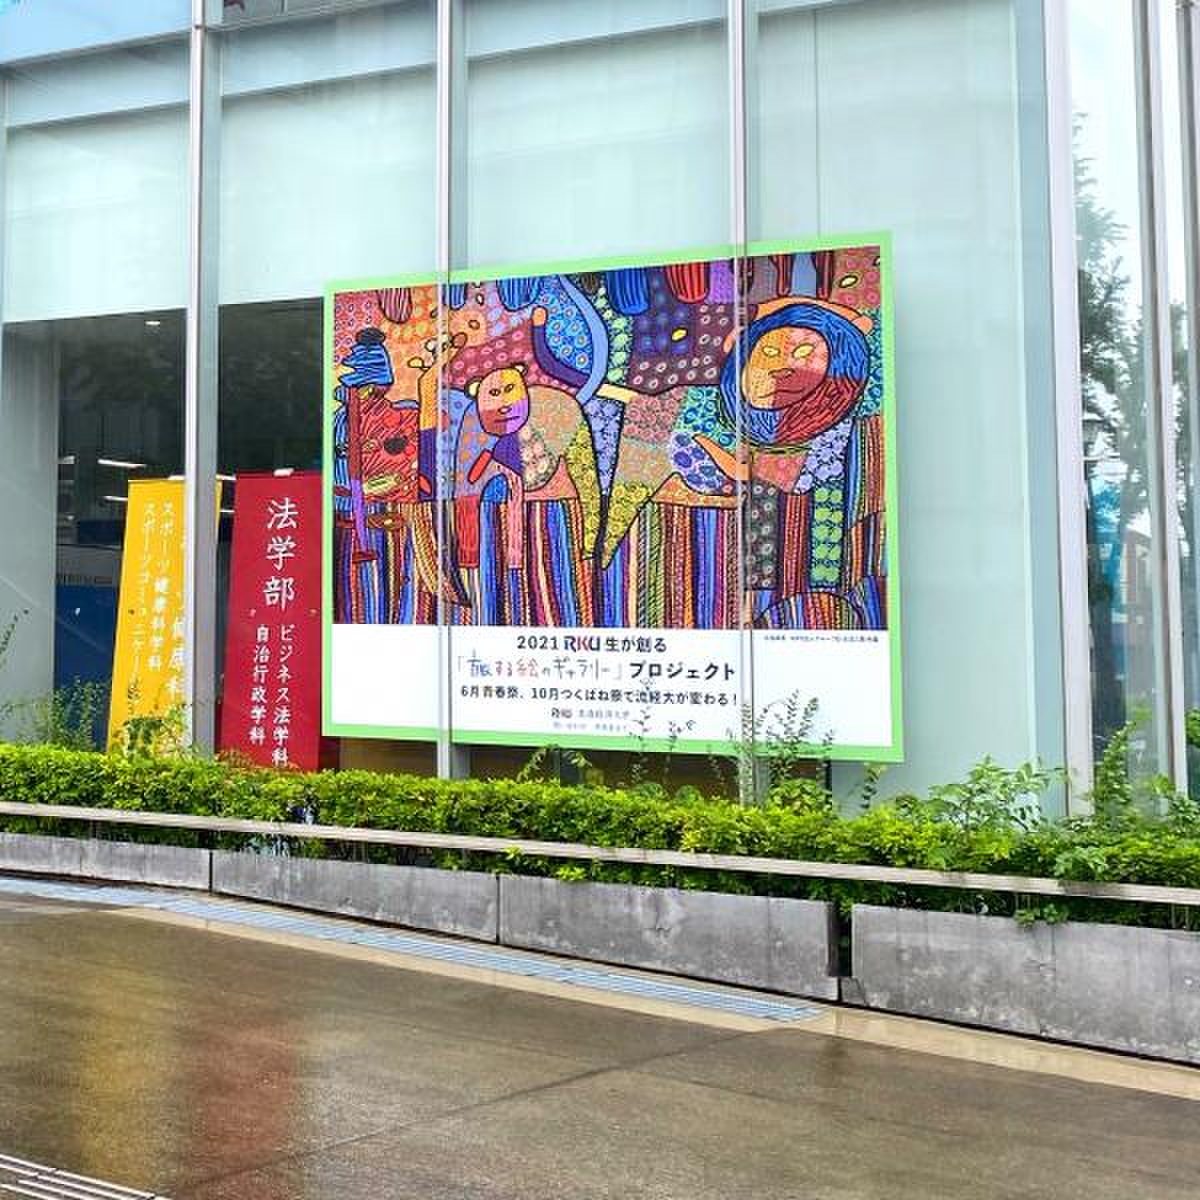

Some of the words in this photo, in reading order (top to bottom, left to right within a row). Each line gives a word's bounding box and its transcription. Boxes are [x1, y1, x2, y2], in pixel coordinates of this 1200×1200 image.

[263, 497, 299, 611] 法学部
[249, 624, 271, 745] 自治行政学科
[272, 624, 295, 767] ビジネス法学科
[517, 635, 558, 650] 2021
[564, 636, 600, 653] RKU
[606, 636, 667, 653] 生が創る
